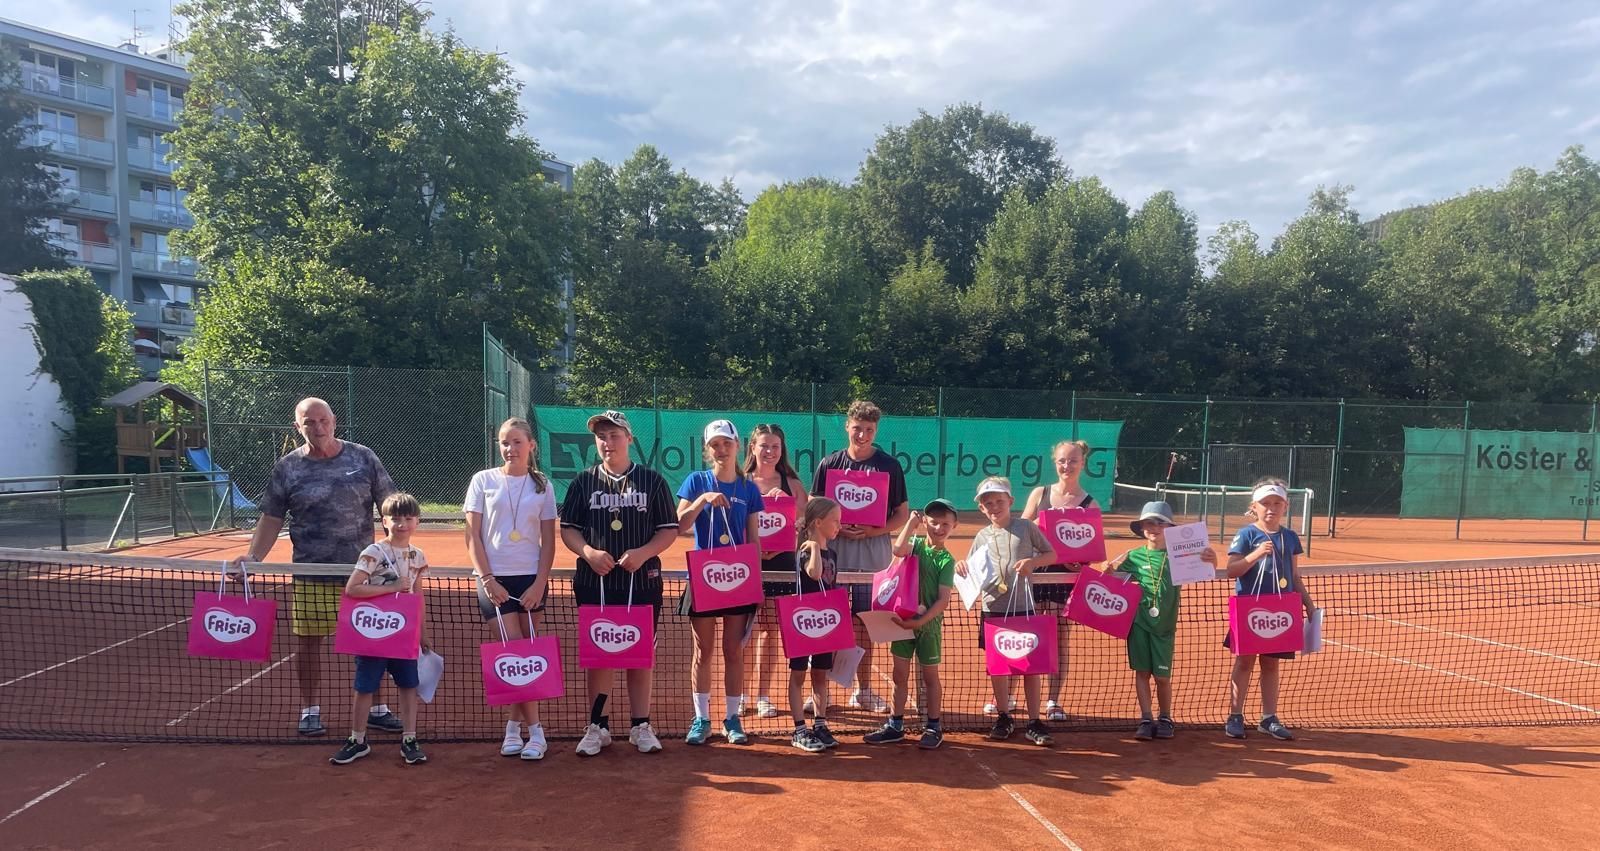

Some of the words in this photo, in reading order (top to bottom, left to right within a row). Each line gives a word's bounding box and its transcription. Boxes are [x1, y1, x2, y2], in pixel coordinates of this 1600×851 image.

[871, 441, 1043, 487] berberg
[1476, 444, 1567, 470] Köster
[1574, 447, 1593, 471] &
[589, 487, 648, 513] Loyalty
[1173, 540, 1206, 551] URKUNDE
